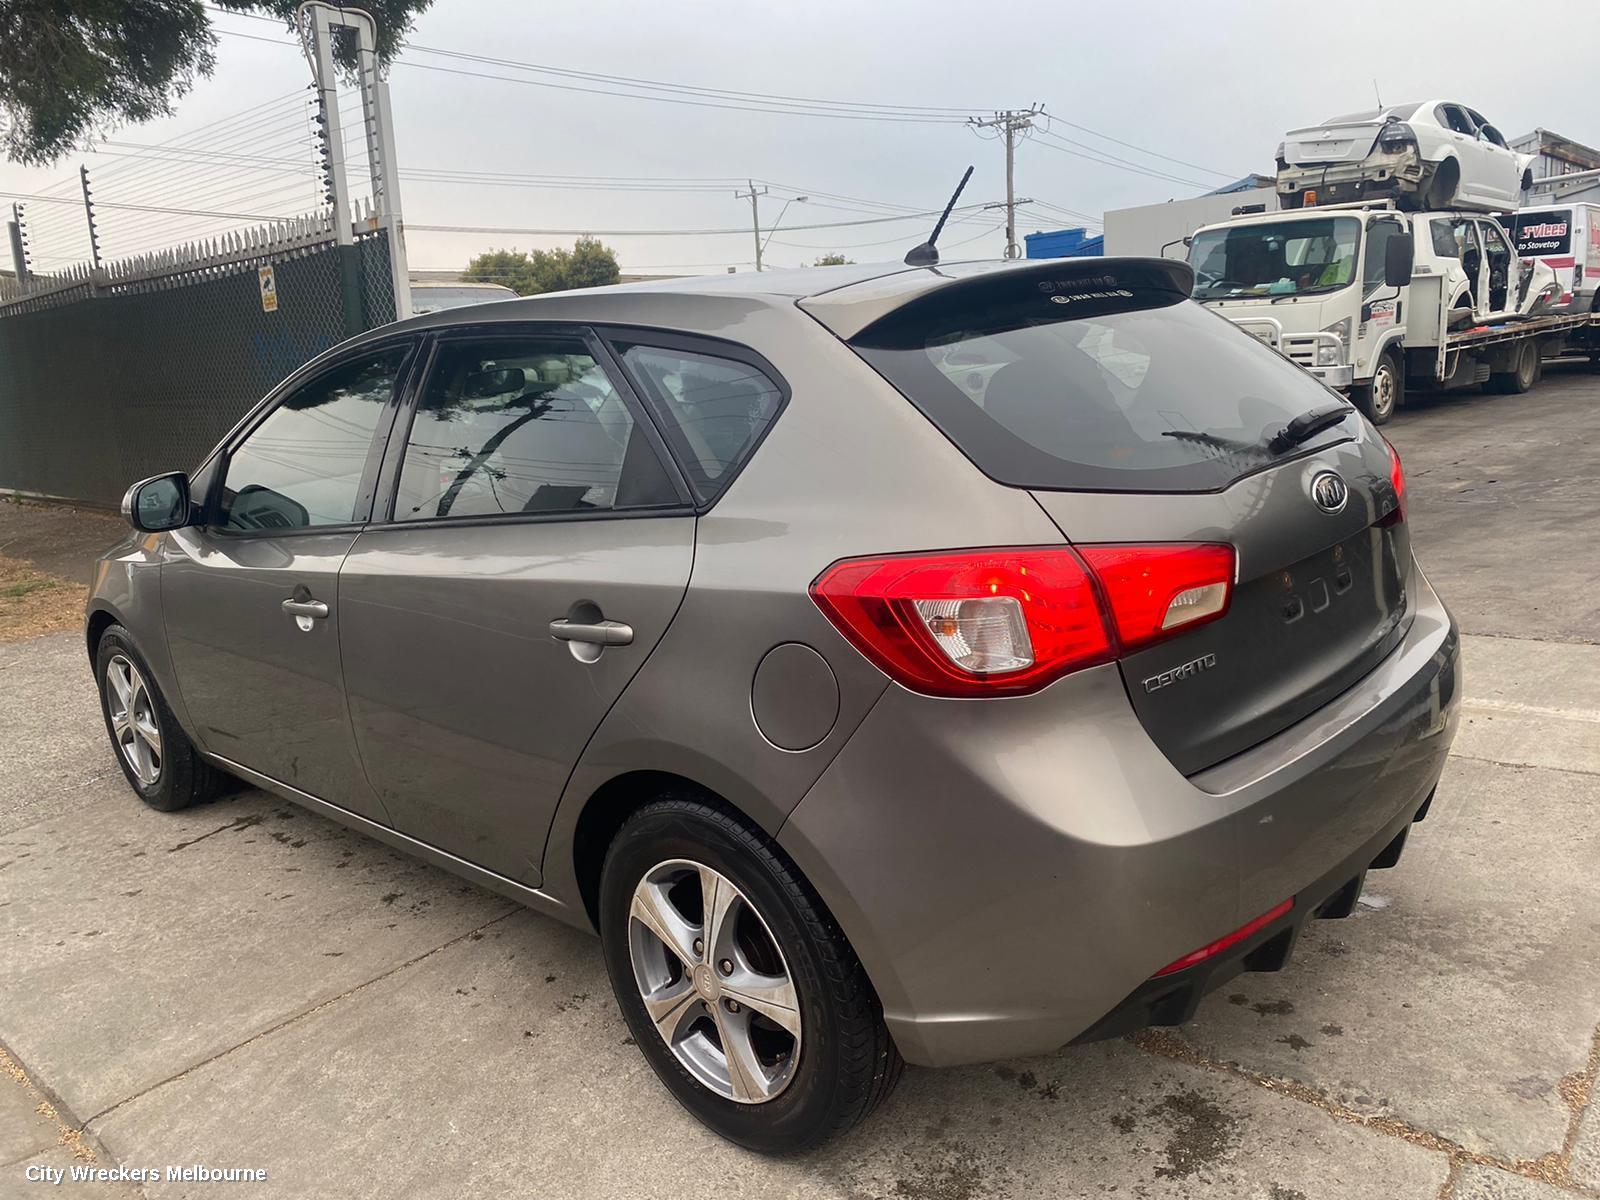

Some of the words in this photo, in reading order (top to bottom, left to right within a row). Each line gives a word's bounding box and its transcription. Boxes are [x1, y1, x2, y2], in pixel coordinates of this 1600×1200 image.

[1521, 223, 1568, 239] rvices
[1527, 241, 1560, 250] Stovetop
[1142, 653, 1217, 693] CERATO
